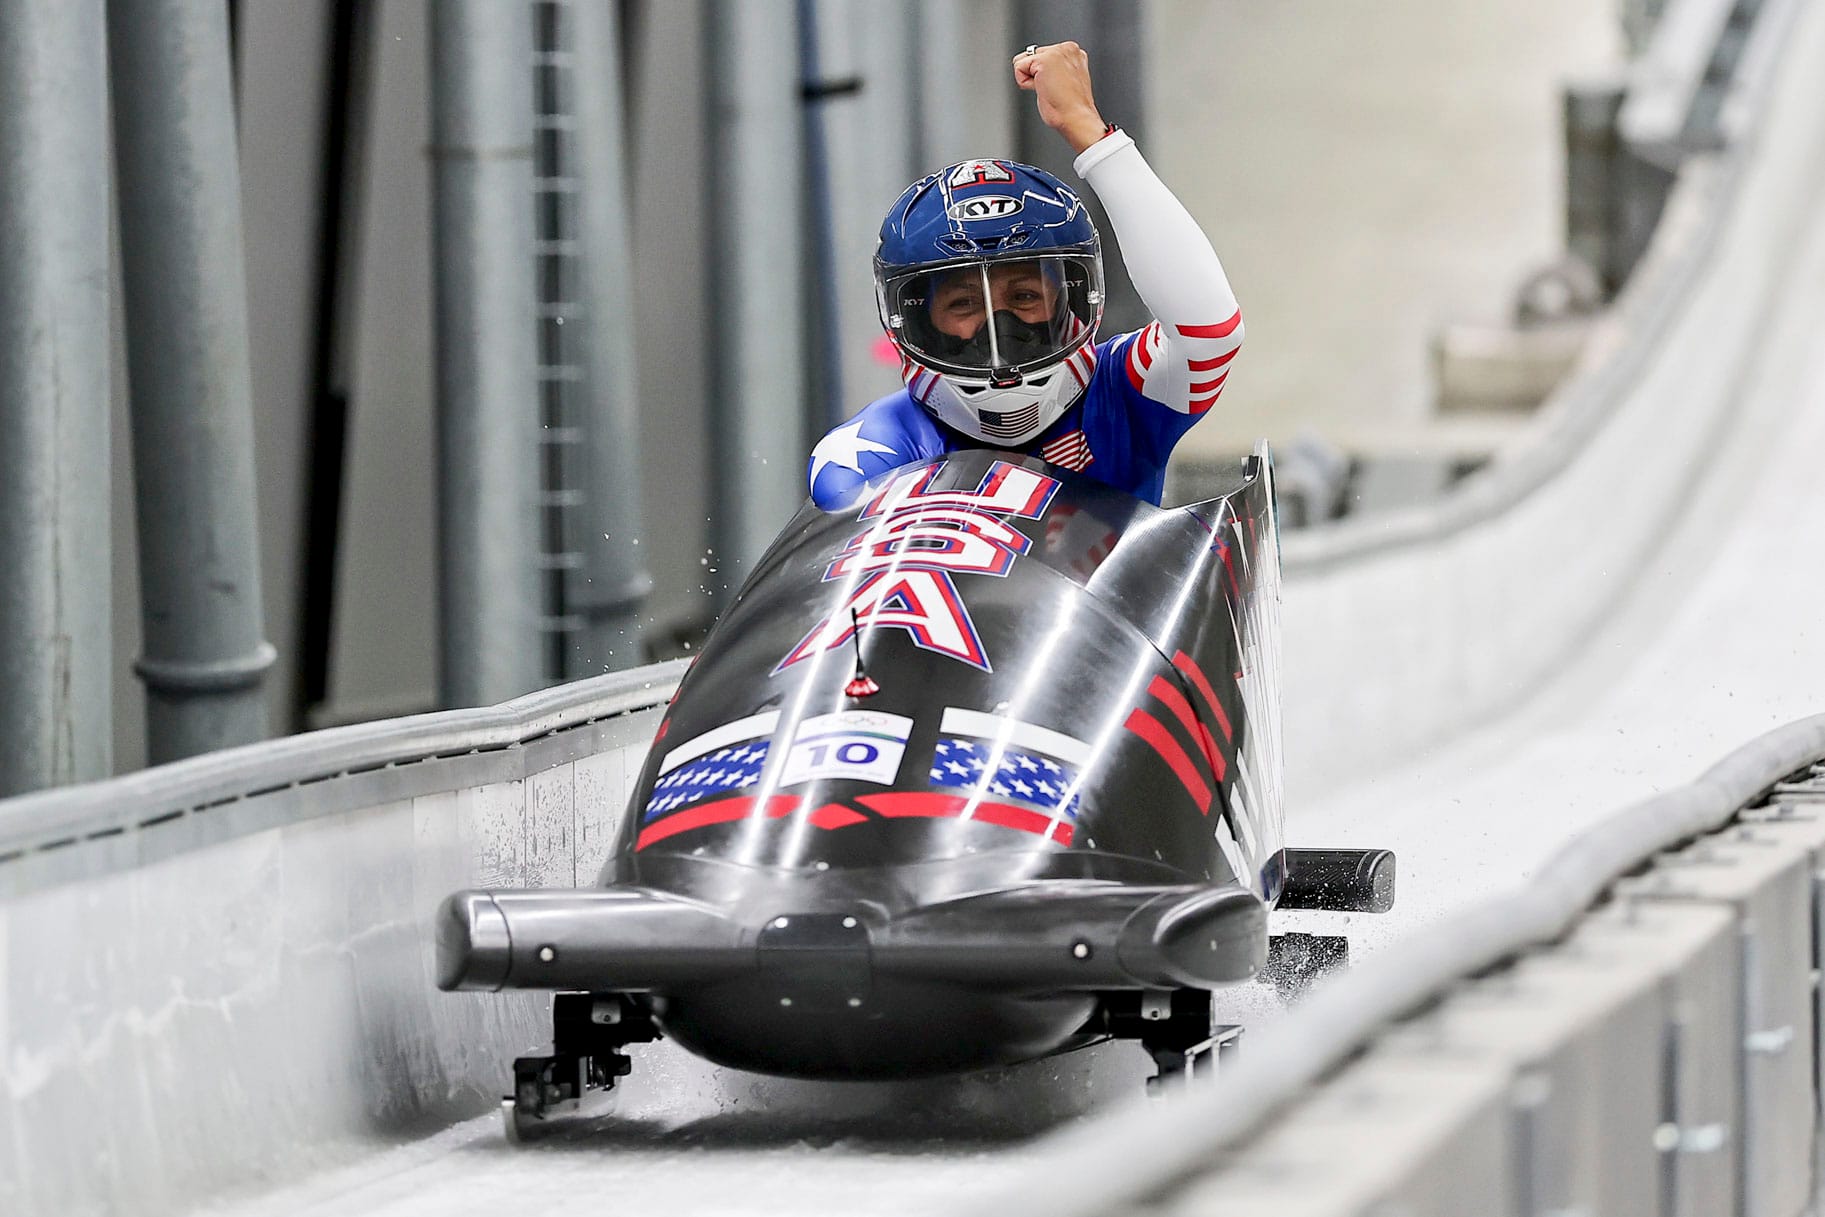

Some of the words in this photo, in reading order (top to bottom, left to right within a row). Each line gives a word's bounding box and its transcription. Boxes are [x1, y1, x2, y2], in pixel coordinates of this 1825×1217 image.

[958, 199, 1013, 218] KYT
[903, 298, 925, 306] KYT
[769, 460, 1062, 677] USA
[808, 742, 879, 767] 10
